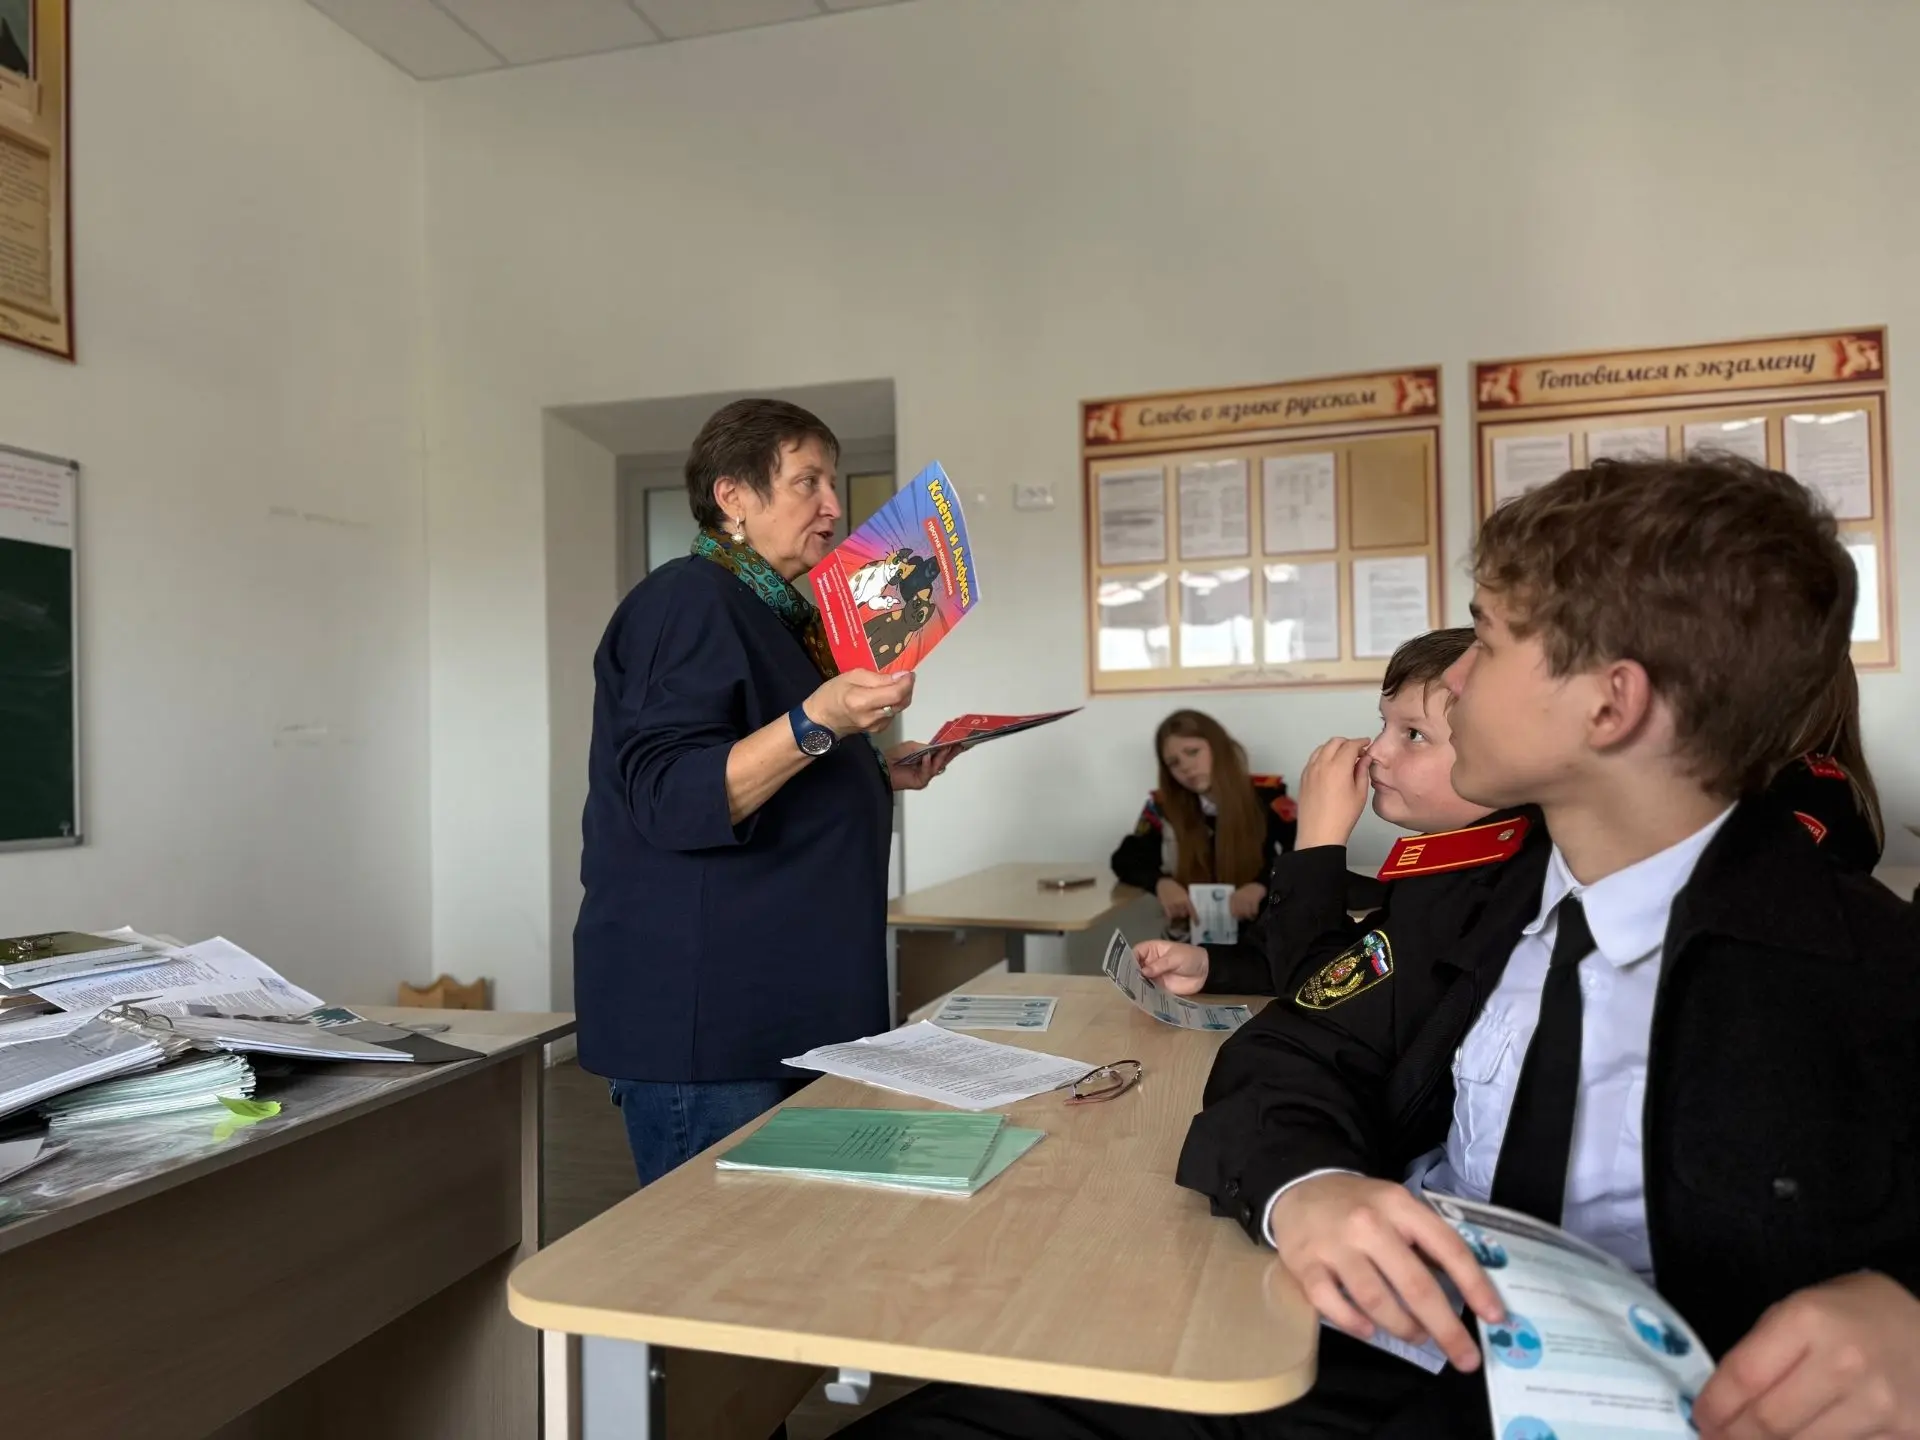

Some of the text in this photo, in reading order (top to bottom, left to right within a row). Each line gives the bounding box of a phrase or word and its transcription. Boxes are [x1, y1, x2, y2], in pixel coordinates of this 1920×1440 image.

[1536, 352, 1816, 390] Готовимся к экзамену
[1138, 391, 1377, 427] Слово о языке русском
[928, 520, 942, 549] против
[928, 479, 970, 609] Клёпа и Анфиса
